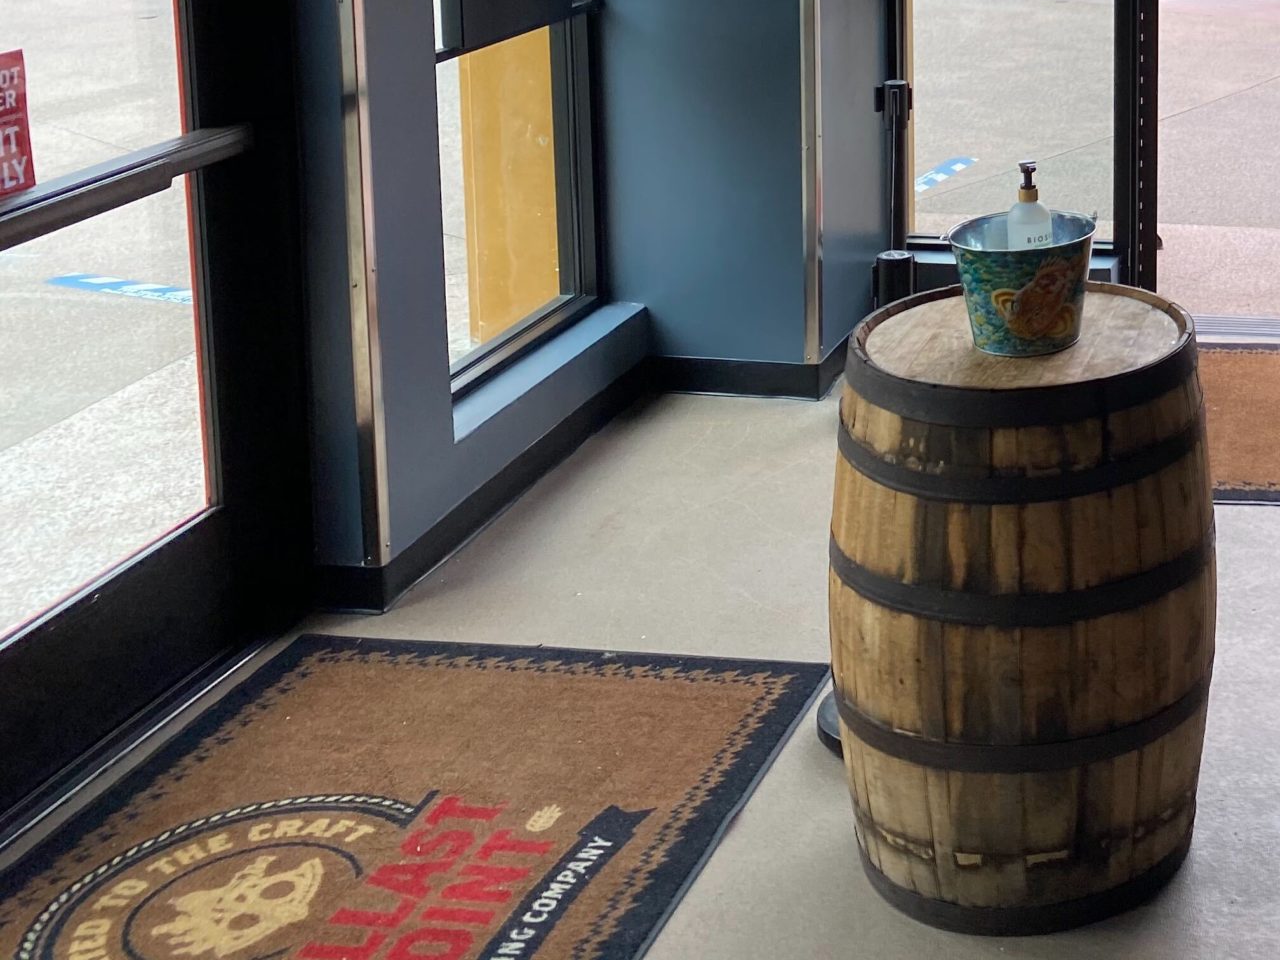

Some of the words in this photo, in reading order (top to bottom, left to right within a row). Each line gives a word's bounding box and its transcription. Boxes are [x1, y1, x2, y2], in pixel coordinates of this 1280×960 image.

[92, 878, 149, 910] TO
[146, 832, 234, 875] THE
[247, 818, 375, 843] CRAFT
[522, 836, 613, 924] COMPANY
